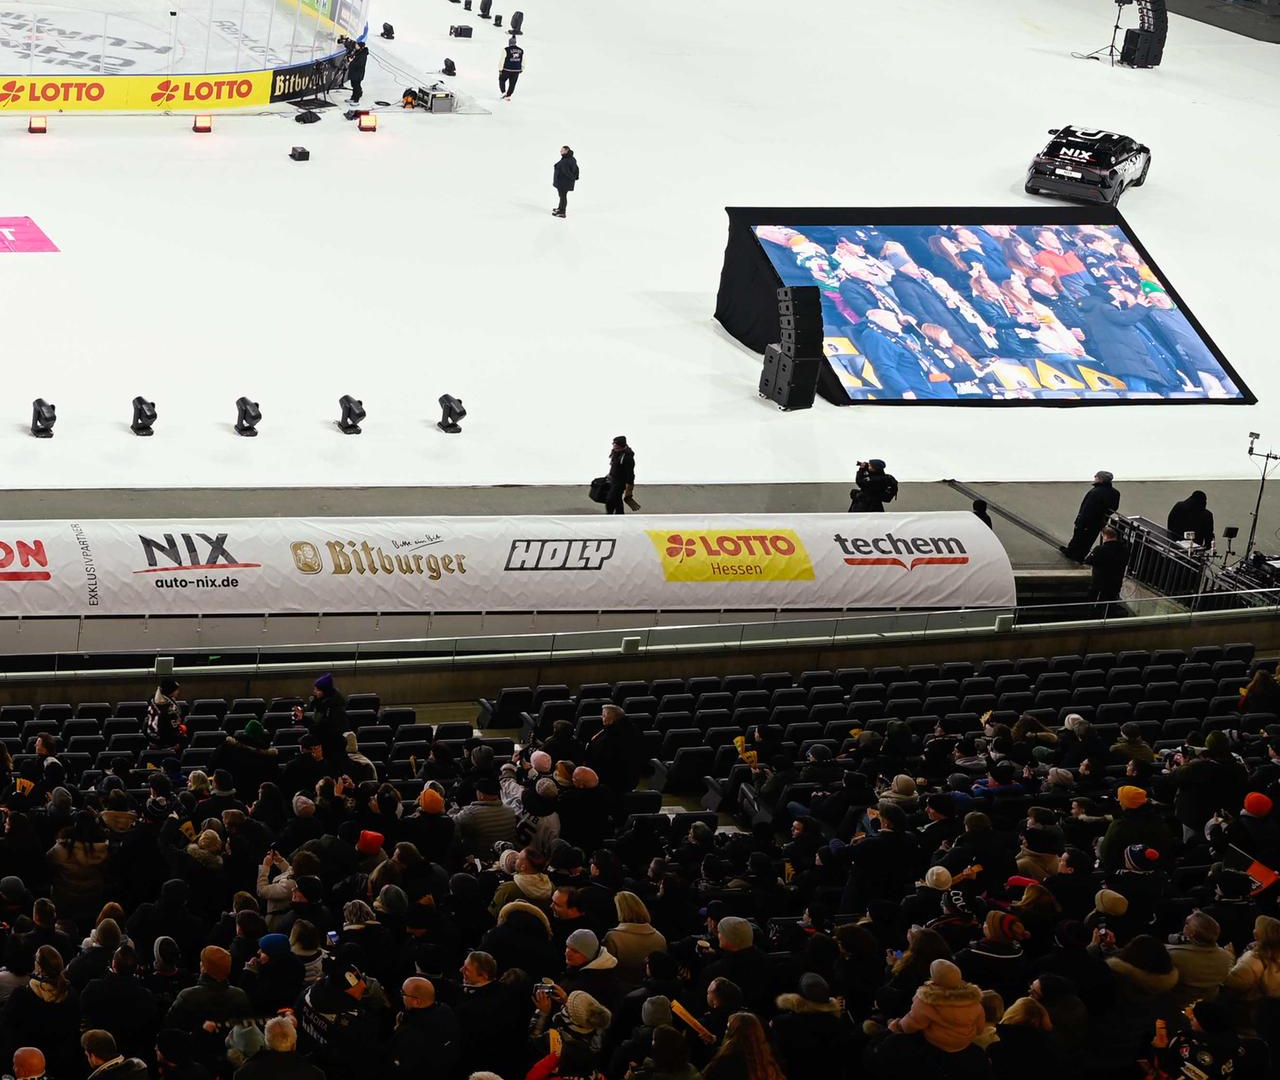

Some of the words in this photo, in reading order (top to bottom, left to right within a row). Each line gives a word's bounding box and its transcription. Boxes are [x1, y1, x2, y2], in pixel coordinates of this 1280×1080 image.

[29, 82, 105, 102] LOTTO
[183, 79, 252, 102] LOTTO
[1059, 148, 1093, 160] NIX
[137, 531, 244, 568] NIX
[503, 538, 617, 572] HOLY
[693, 535, 796, 559] LOTTO
[834, 532, 968, 558] techem
[71, 521, 100, 607] EXKLUSIVPARTNER
[331, 539, 466, 581] Bitburger
[710, 561, 763, 579] Hessen
[155, 576, 238, 588] auto-nix.de
